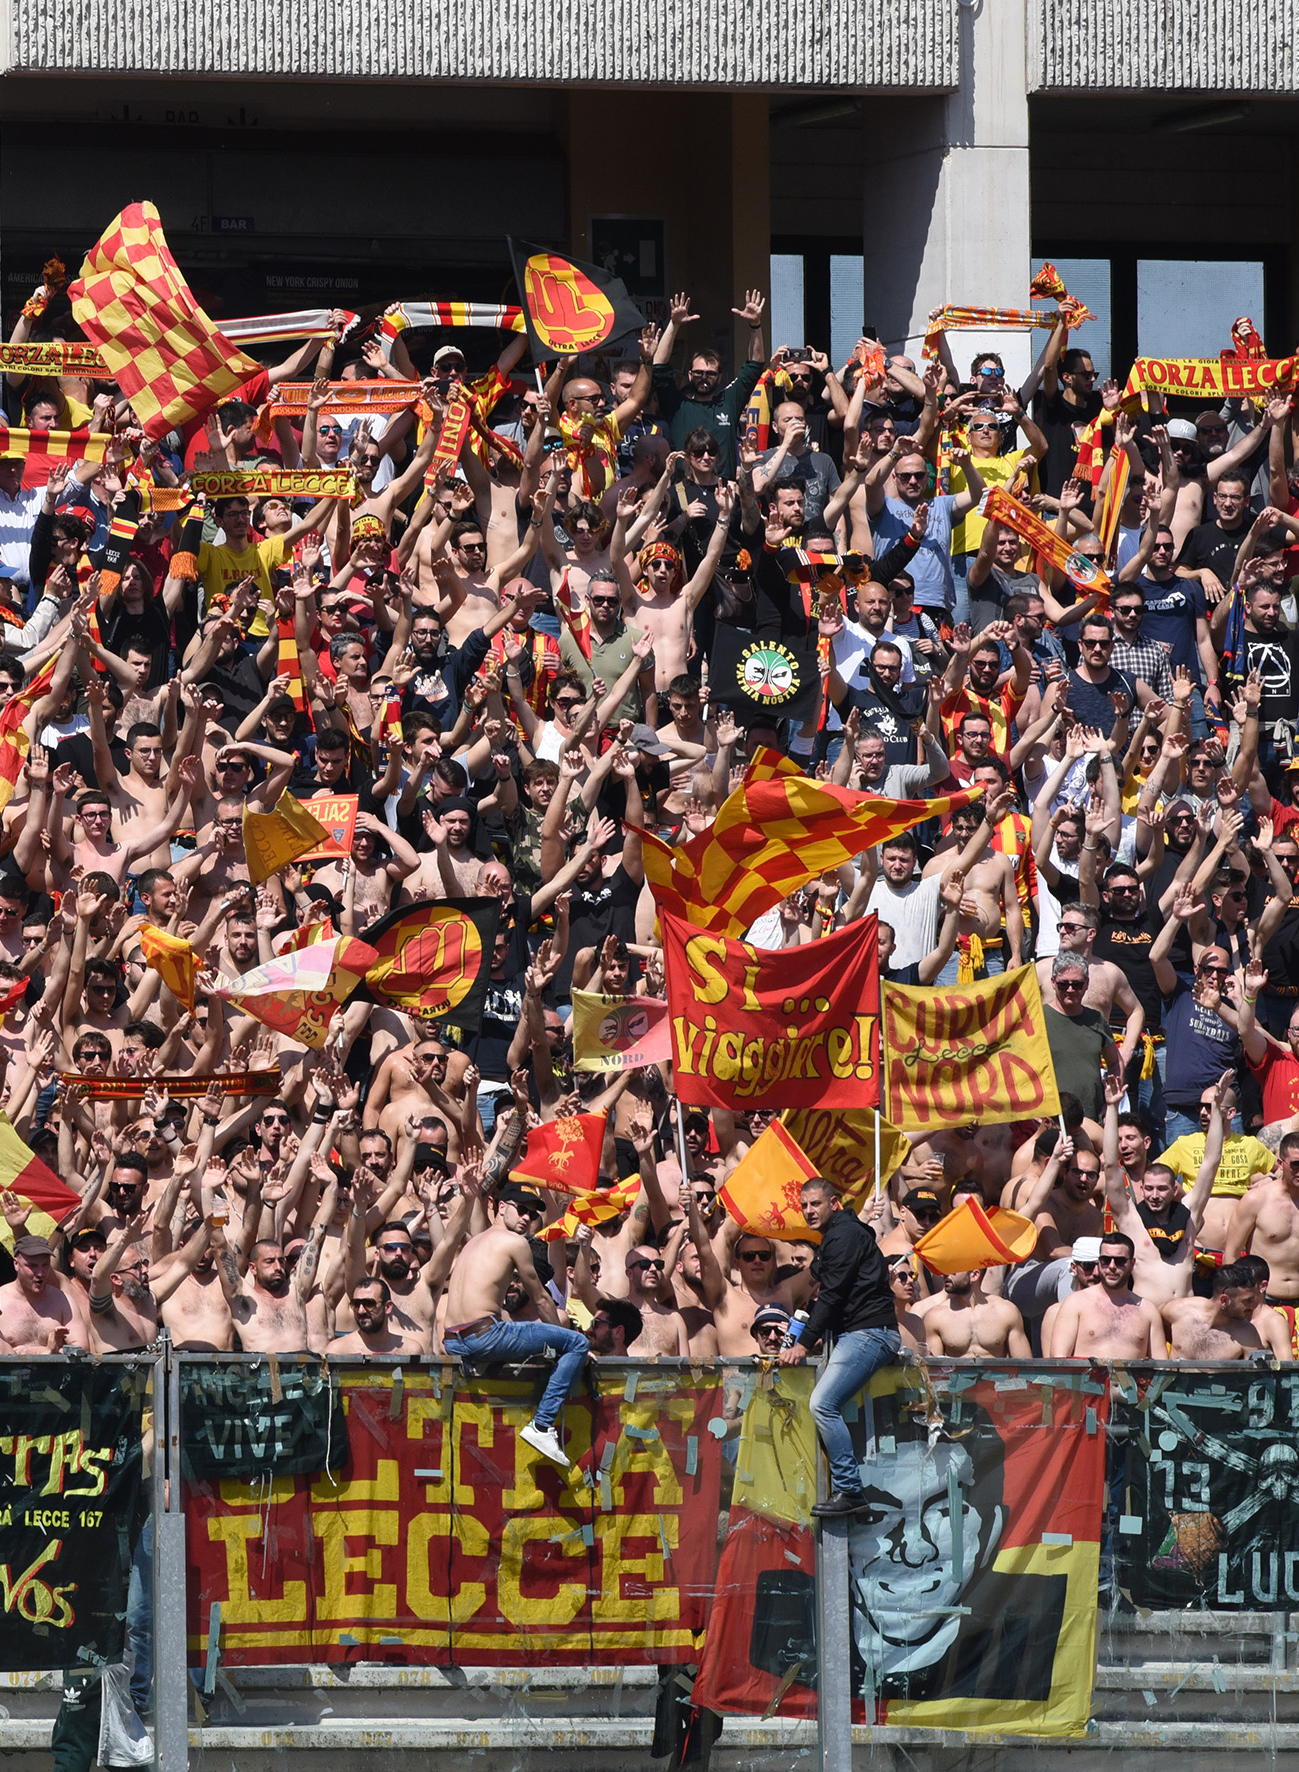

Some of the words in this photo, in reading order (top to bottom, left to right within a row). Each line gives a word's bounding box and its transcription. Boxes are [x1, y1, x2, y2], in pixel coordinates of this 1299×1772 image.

[220, 218, 248, 230] BAR
[7, 272, 45, 284] AMERICA
[266, 275, 284, 287] NEW
[285, 276, 305, 288] YORK
[306, 276, 334, 289] CRISPY
[335, 277, 359, 289] ONION
[66, 346, 108, 368] LEC
[1134, 359, 1218, 390] FORZA
[372, 386, 421, 401] LECC
[192, 473, 269, 494] FORZA
[276, 473, 351, 495] LECCE
[741, 640, 799, 671] SALENTO
[762, 677, 801, 706] NOSTRA
[885, 981, 1036, 1055] CURVA
[600, 1053, 645, 1067] NORD
[904, 1037, 1012, 1067] Lecce
[890, 1051, 1045, 1125] NORD
[203, 1414, 294, 1461] VIVE
[218, 1395, 698, 1511] LTRA
[24, 1509, 70, 1528] LECCE
[78, 1510, 104, 1529] 167
[206, 1509, 681, 1627] LECCE
